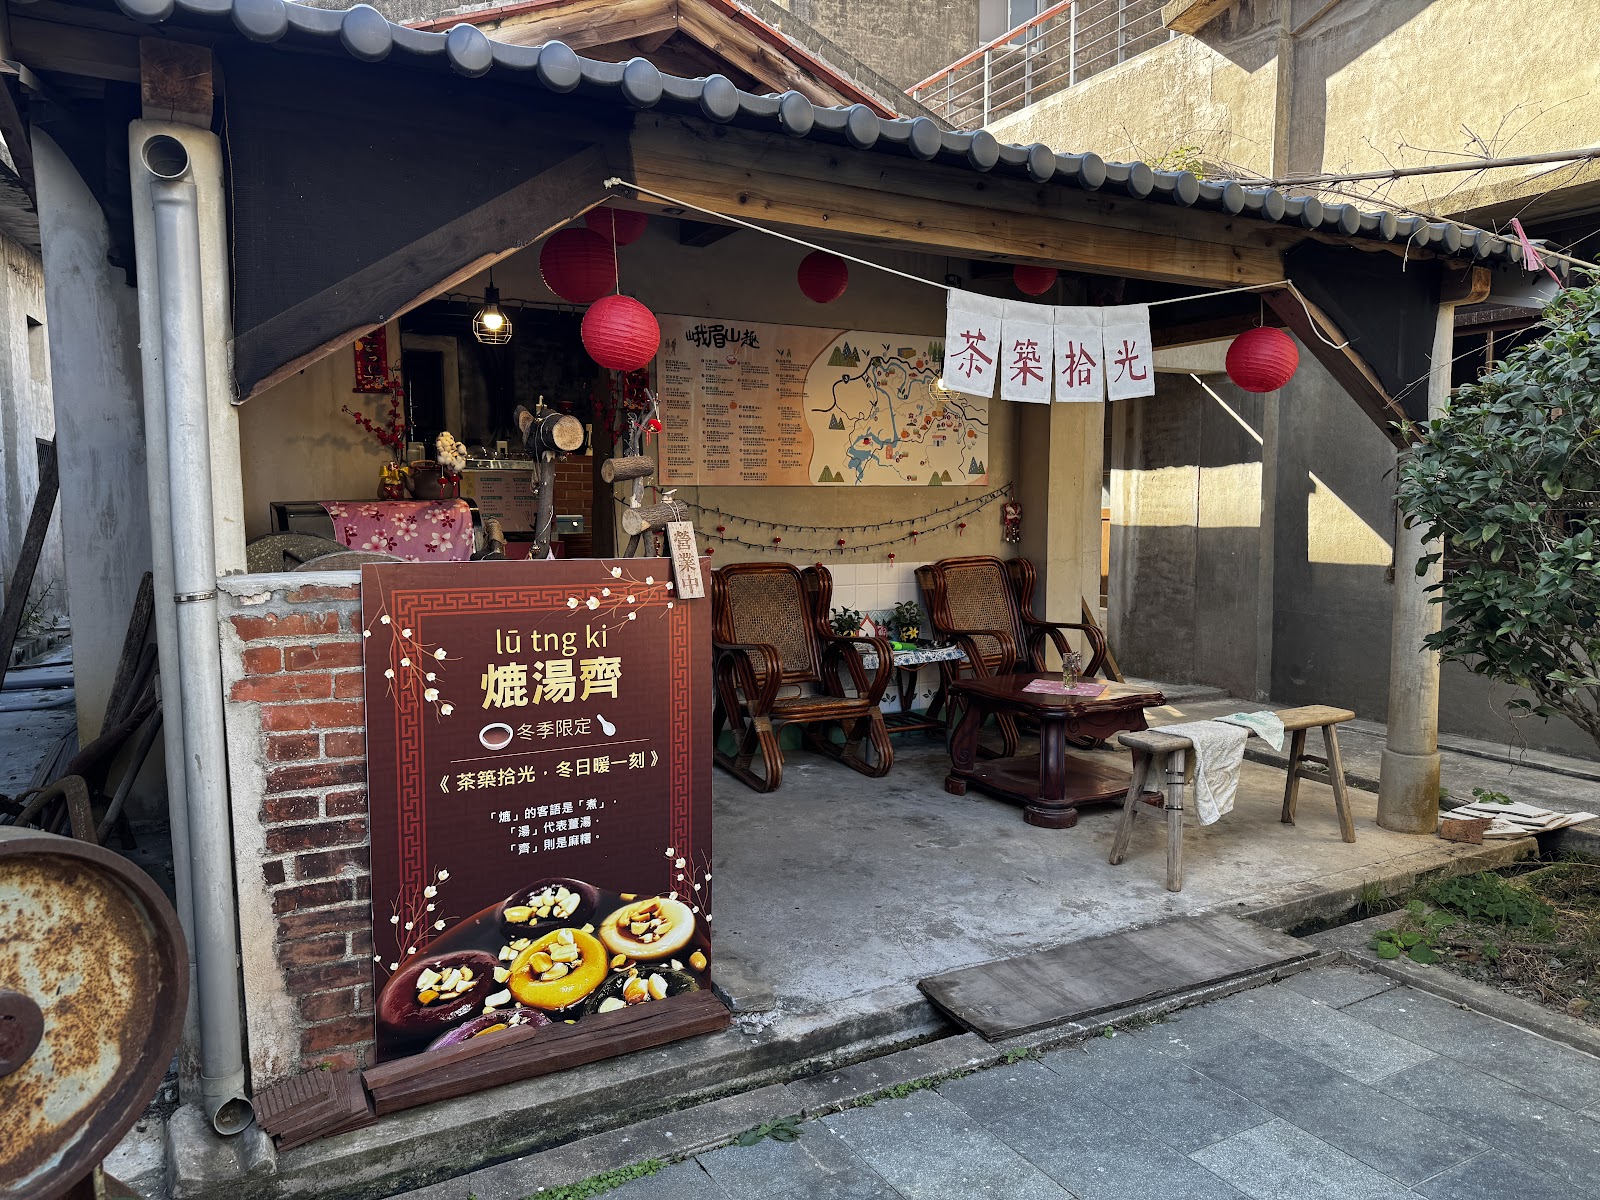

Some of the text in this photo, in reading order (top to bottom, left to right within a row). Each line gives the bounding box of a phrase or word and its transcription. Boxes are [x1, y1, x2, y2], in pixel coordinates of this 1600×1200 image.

[685, 323, 761, 349] 峨眉山趣
[950, 328, 1147, 388] 茶築拾光
[673, 530, 699, 595] 營業中
[496, 624, 608, 656] lū tng ki
[480, 656, 622, 710] 熝湯齊
[516, 717, 592, 741] 冬季限定
